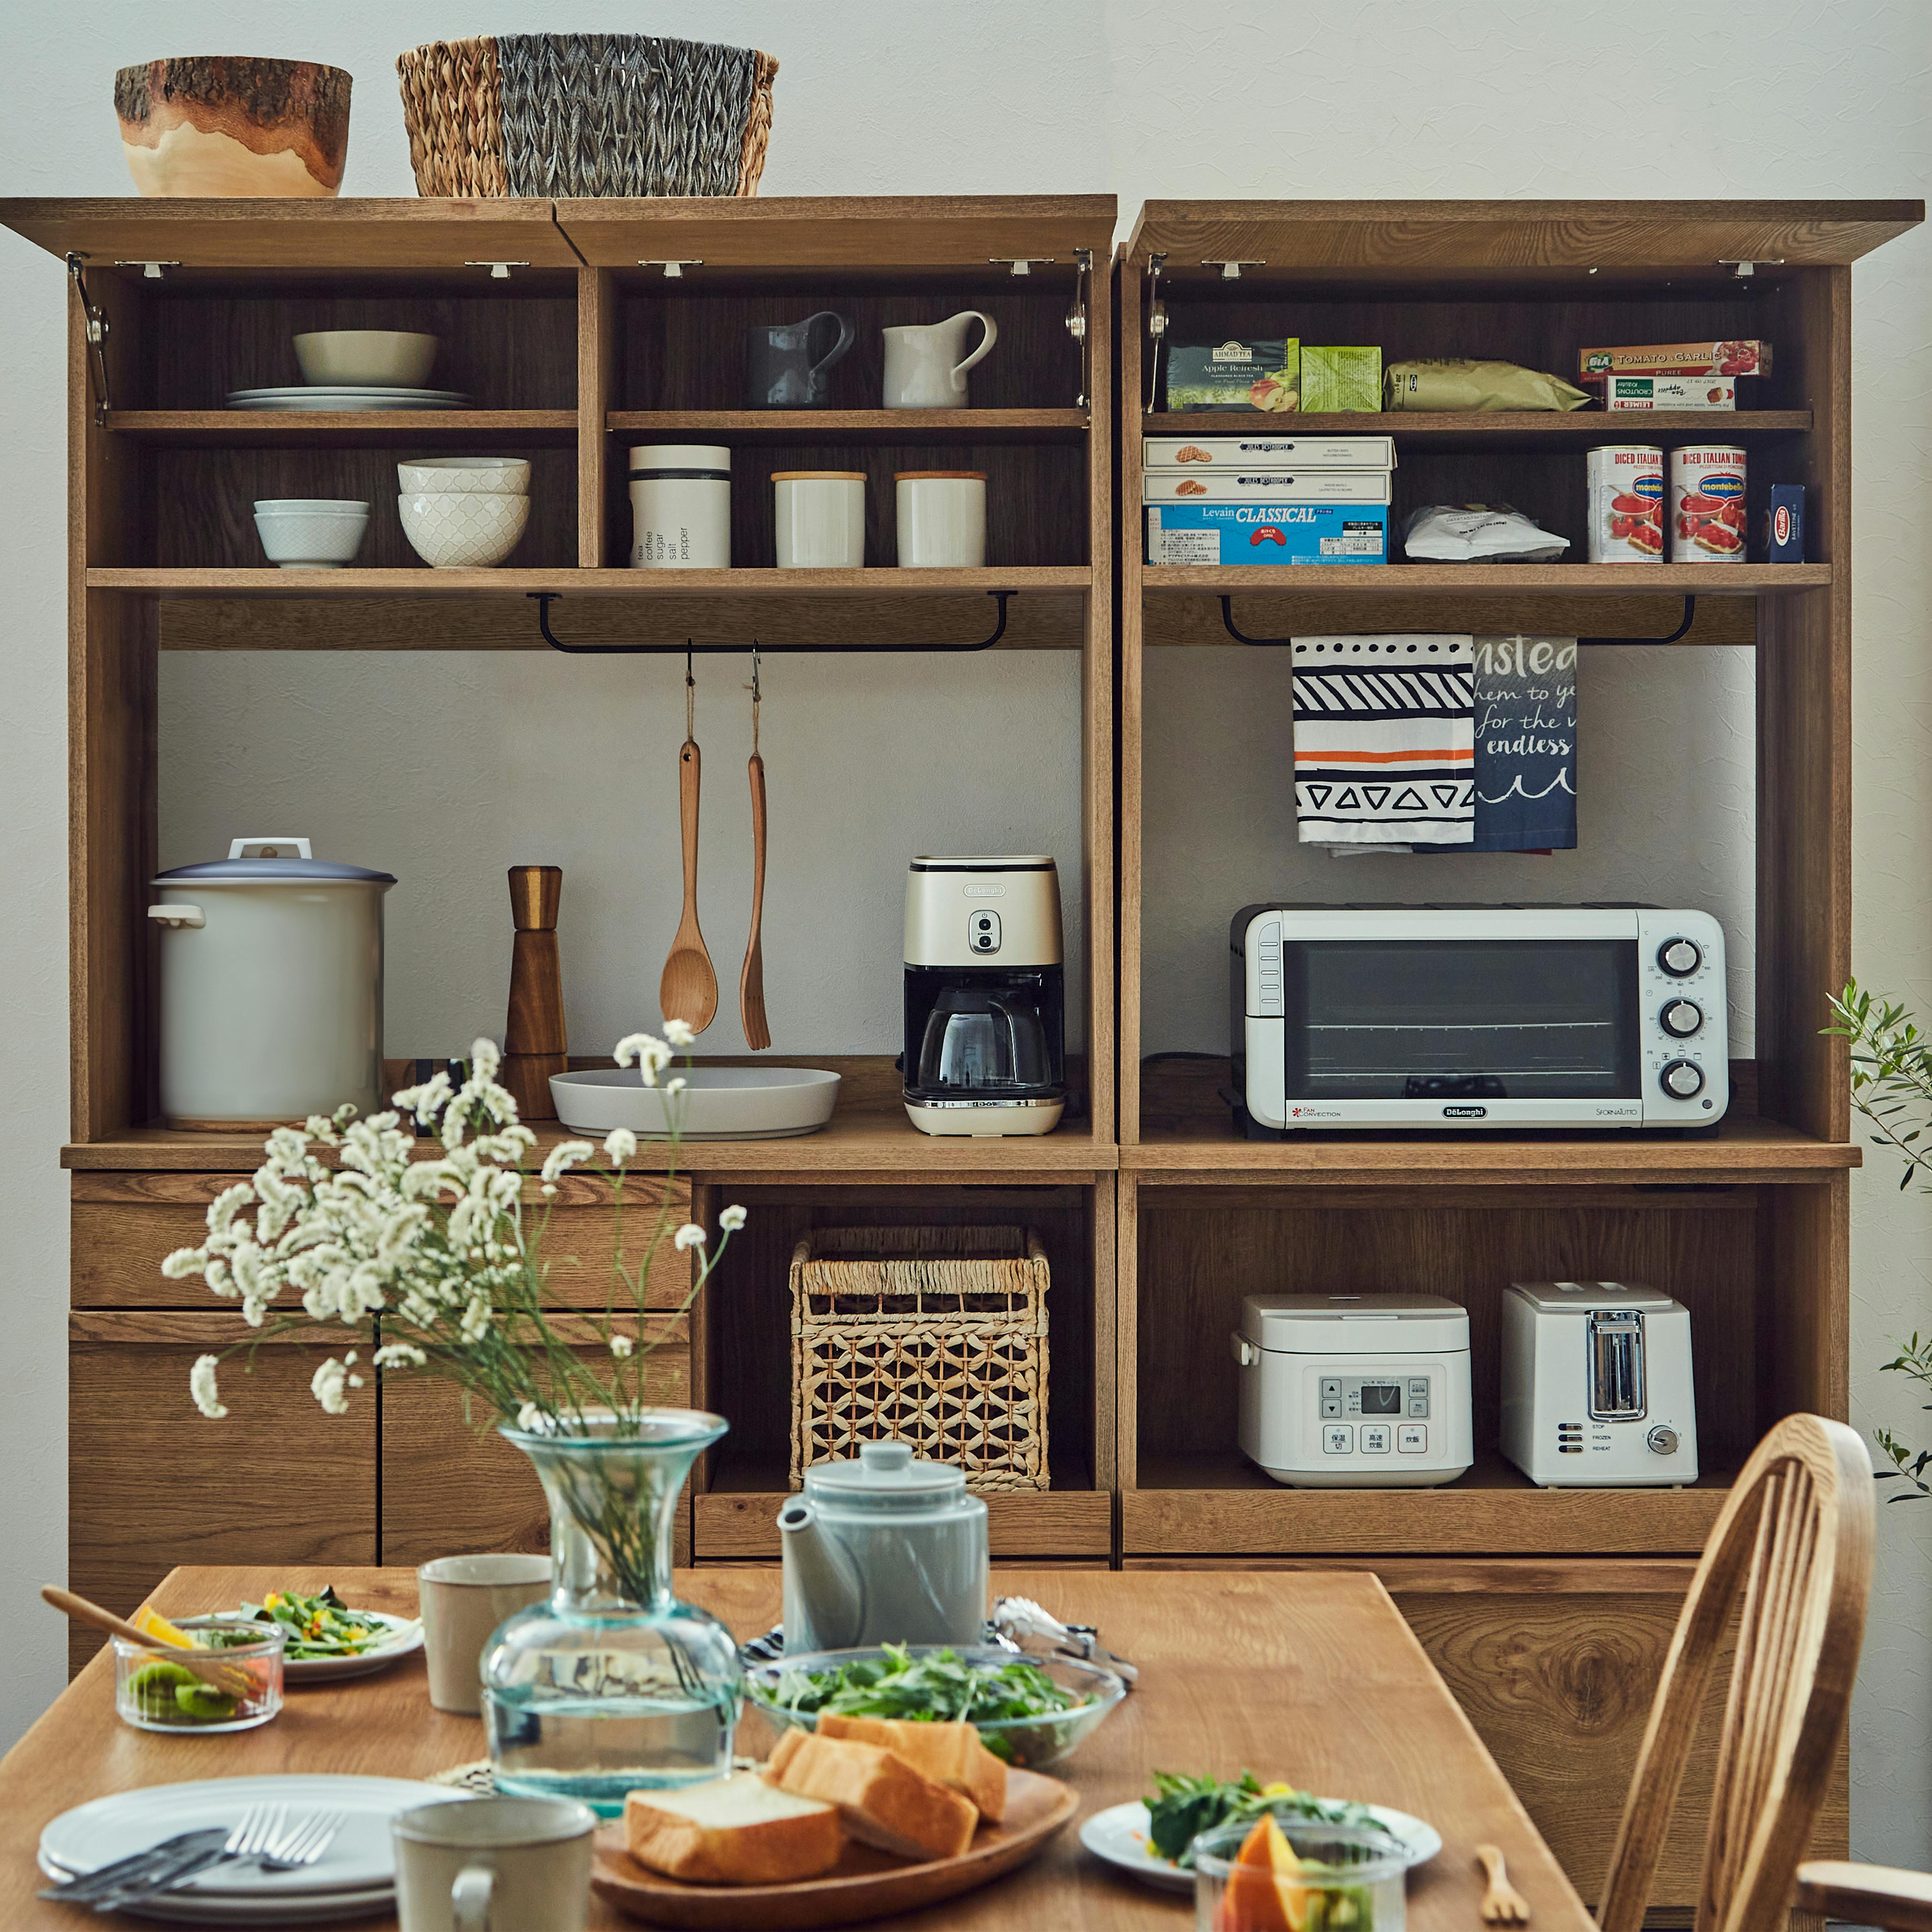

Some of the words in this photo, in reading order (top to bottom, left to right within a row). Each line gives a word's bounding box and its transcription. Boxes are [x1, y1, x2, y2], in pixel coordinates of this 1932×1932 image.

[1617, 354, 1667, 365] TOMATO
[1674, 352, 1722, 362] GARLIC
[1615, 453, 1635, 465] DICED
[1637, 453, 1658, 465] ITALIAN
[1683, 454, 1701, 465] DICED
[1703, 452, 1730, 464] ITALIAN
[1203, 508, 1234, 516] Levain
[1236, 507, 1317, 523] CLASSICAL
[656, 533, 666, 560] sugar
[667, 543, 676, 560] salt
[681, 527, 690, 560] pepper
[1527, 686, 1549, 700] to
[1475, 704, 1513, 739] for
[1519, 704, 1561, 729] the
[1487, 735, 1573, 755] endless
